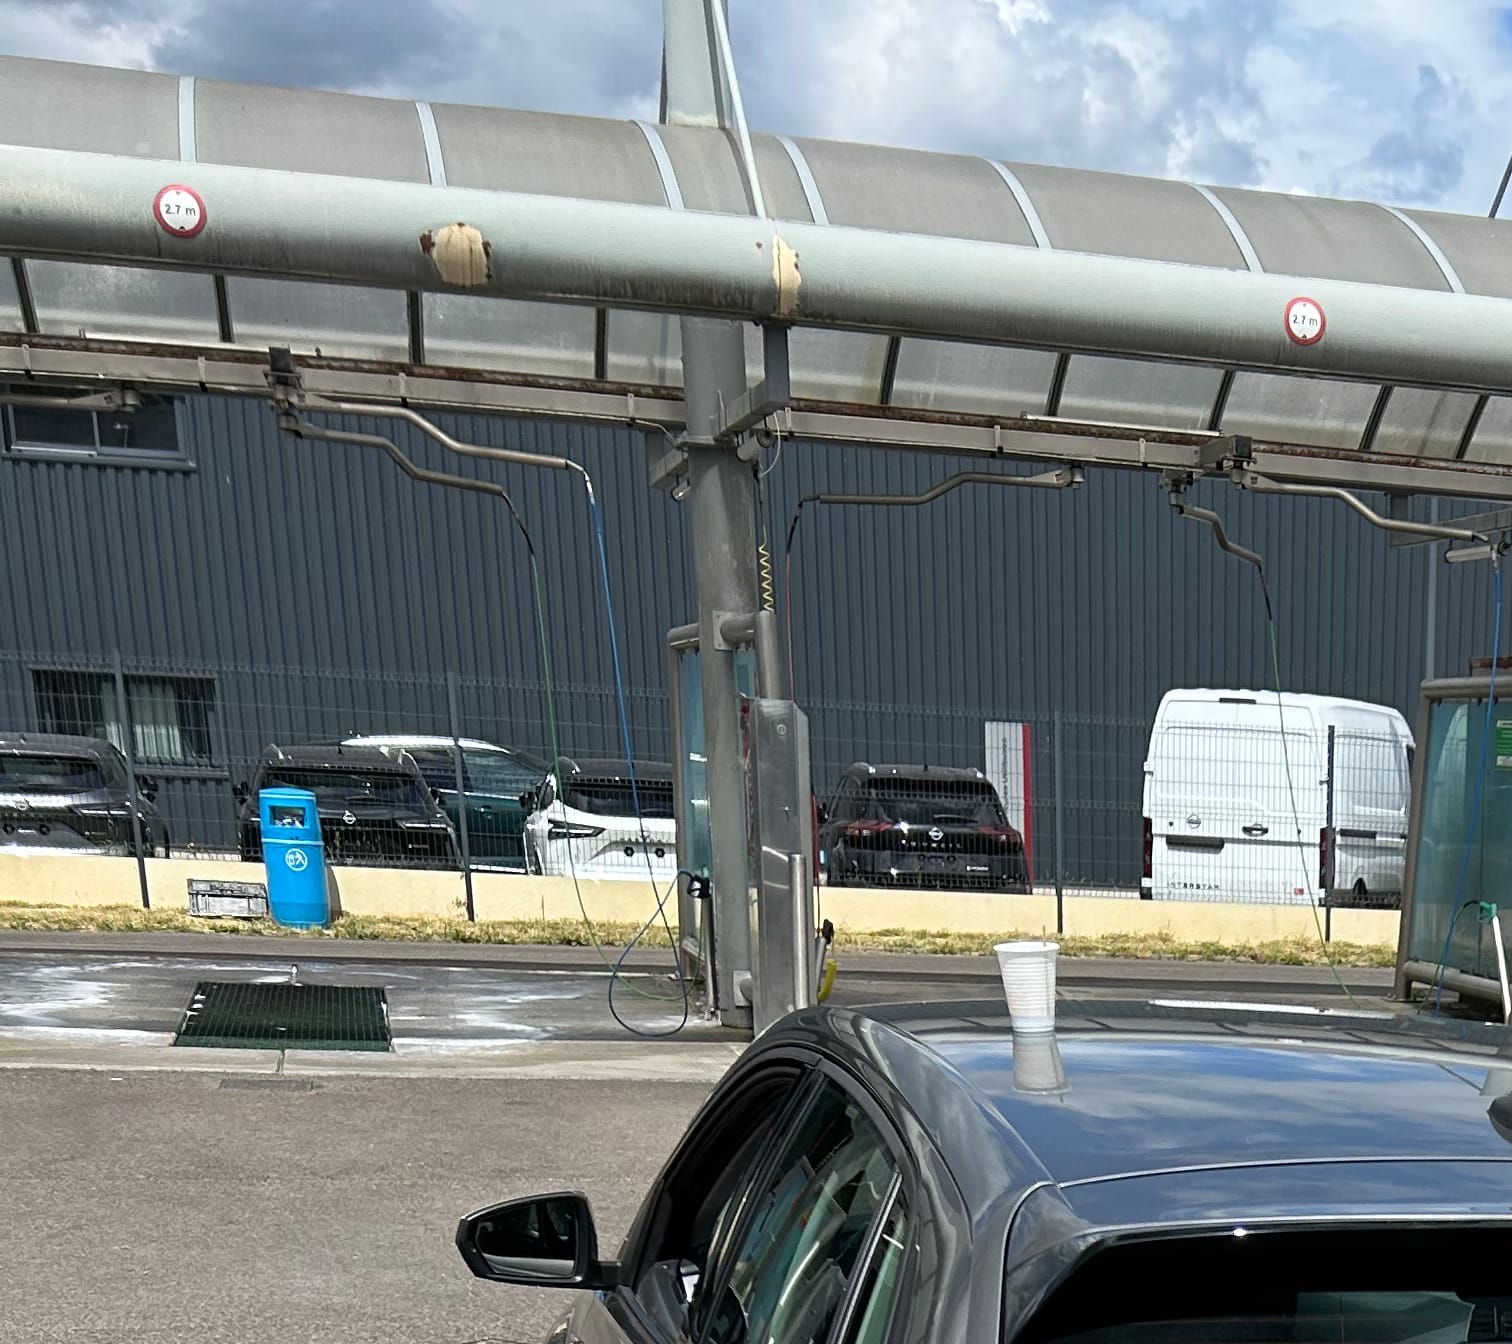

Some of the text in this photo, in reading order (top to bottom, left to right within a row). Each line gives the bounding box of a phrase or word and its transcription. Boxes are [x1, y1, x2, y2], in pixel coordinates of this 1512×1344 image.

[164, 203, 196, 216] 2.7 m
[1309, 318, 1317, 326] m
